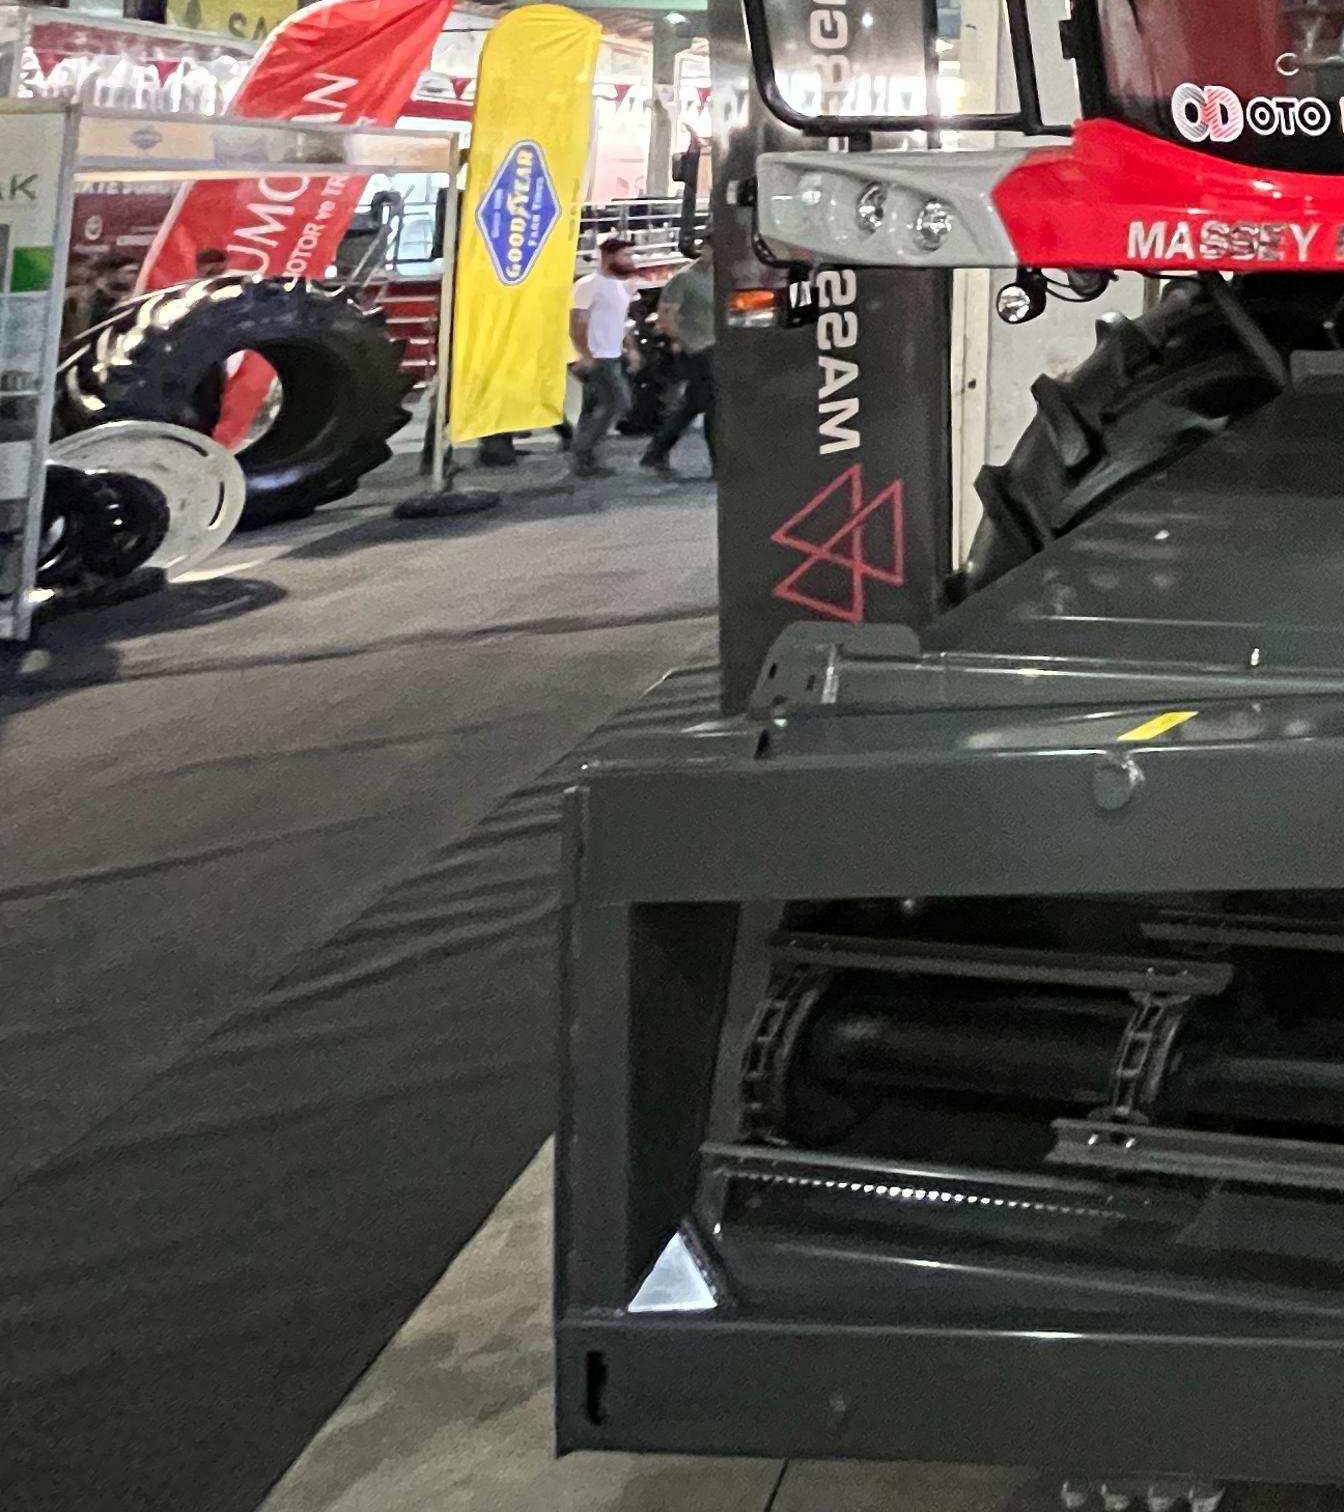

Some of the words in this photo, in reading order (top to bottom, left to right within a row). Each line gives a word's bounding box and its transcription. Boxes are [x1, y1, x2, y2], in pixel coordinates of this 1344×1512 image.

[1246, 96, 1332, 136] OTO
[505, 150, 534, 278] GOODYEAR
[1127, 221, 1318, 262] MASSEY
